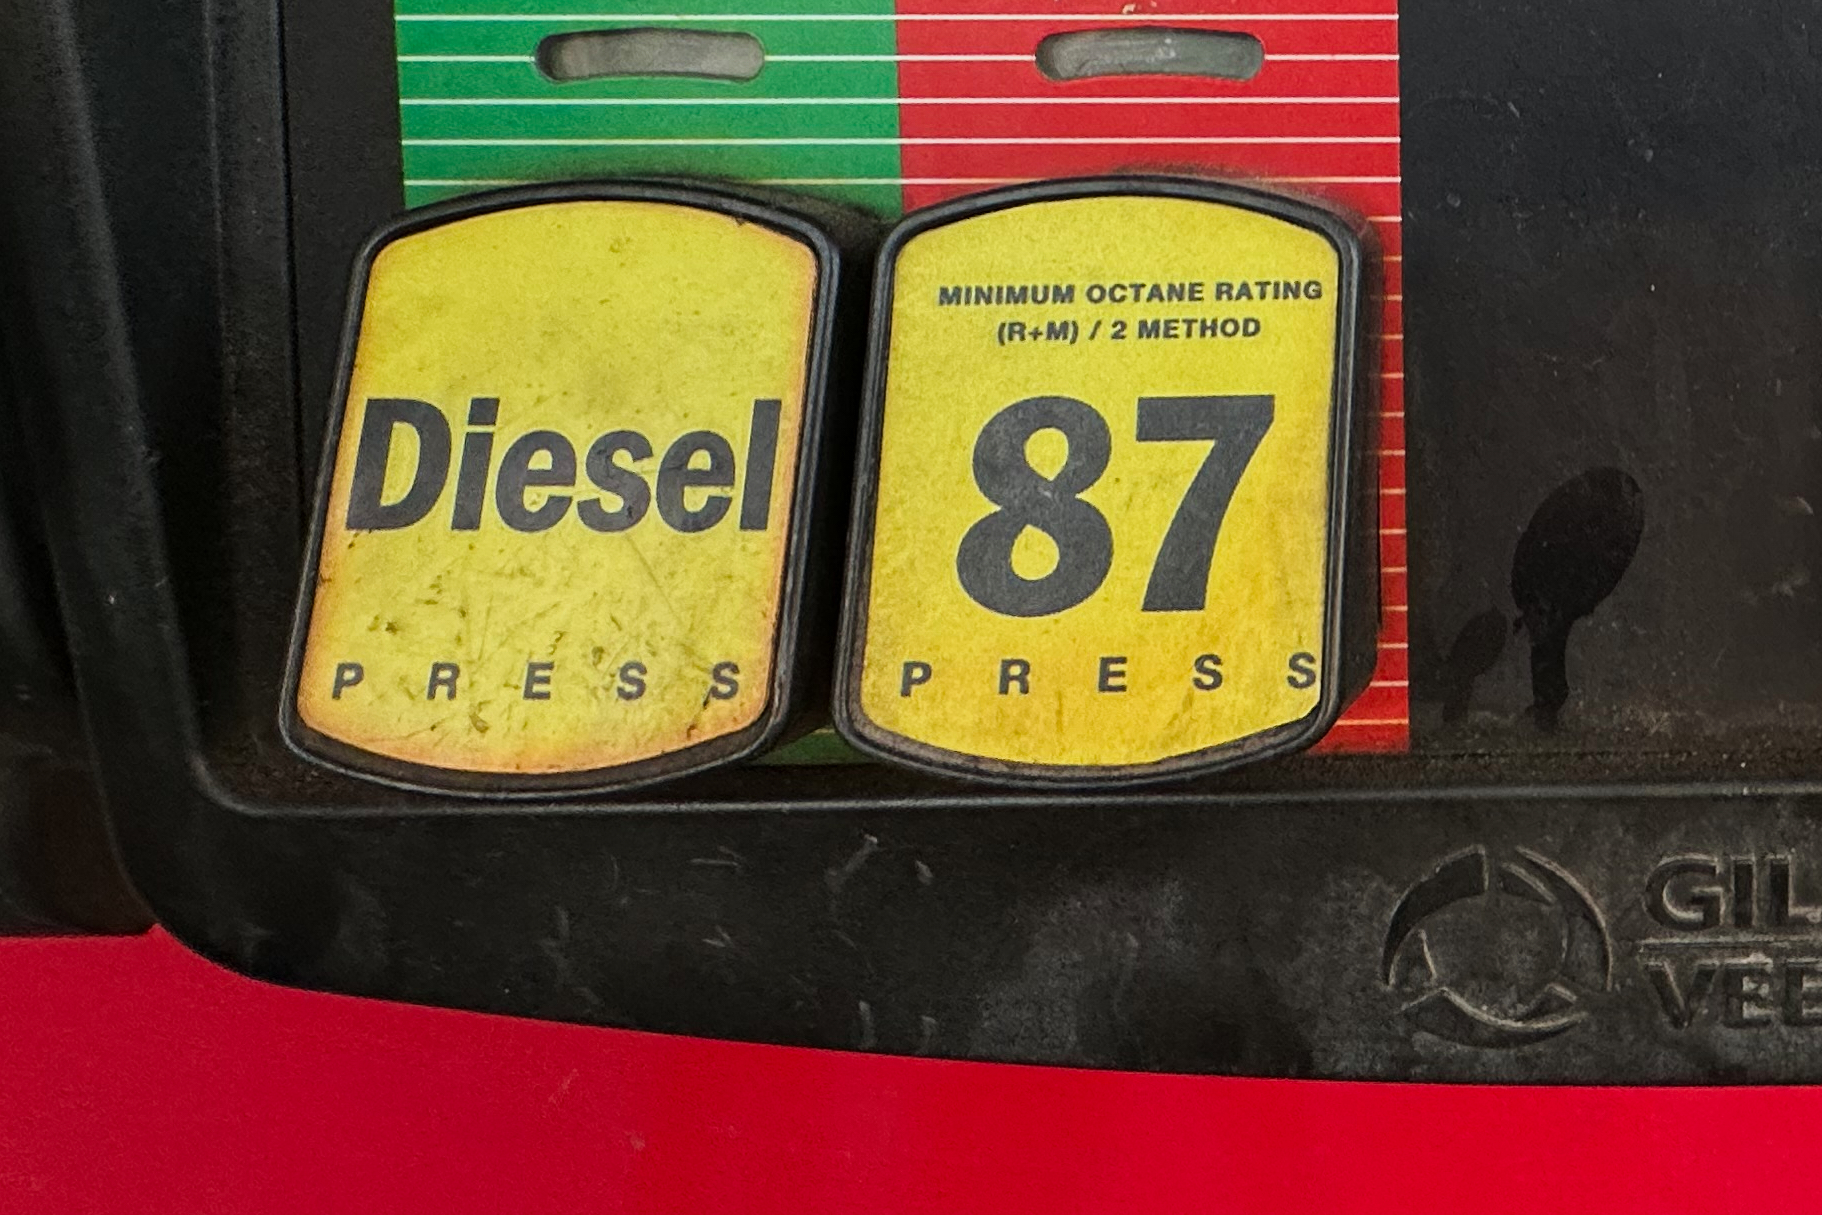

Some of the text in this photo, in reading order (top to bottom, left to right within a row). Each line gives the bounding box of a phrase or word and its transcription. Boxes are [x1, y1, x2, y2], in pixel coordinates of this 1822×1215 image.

[939, 280, 1323, 306] MINIMUM OCTANE RATING
[1138, 318, 1261, 339] METHOD
[345, 397, 782, 534] Diesel
[956, 393, 1275, 618] 87
